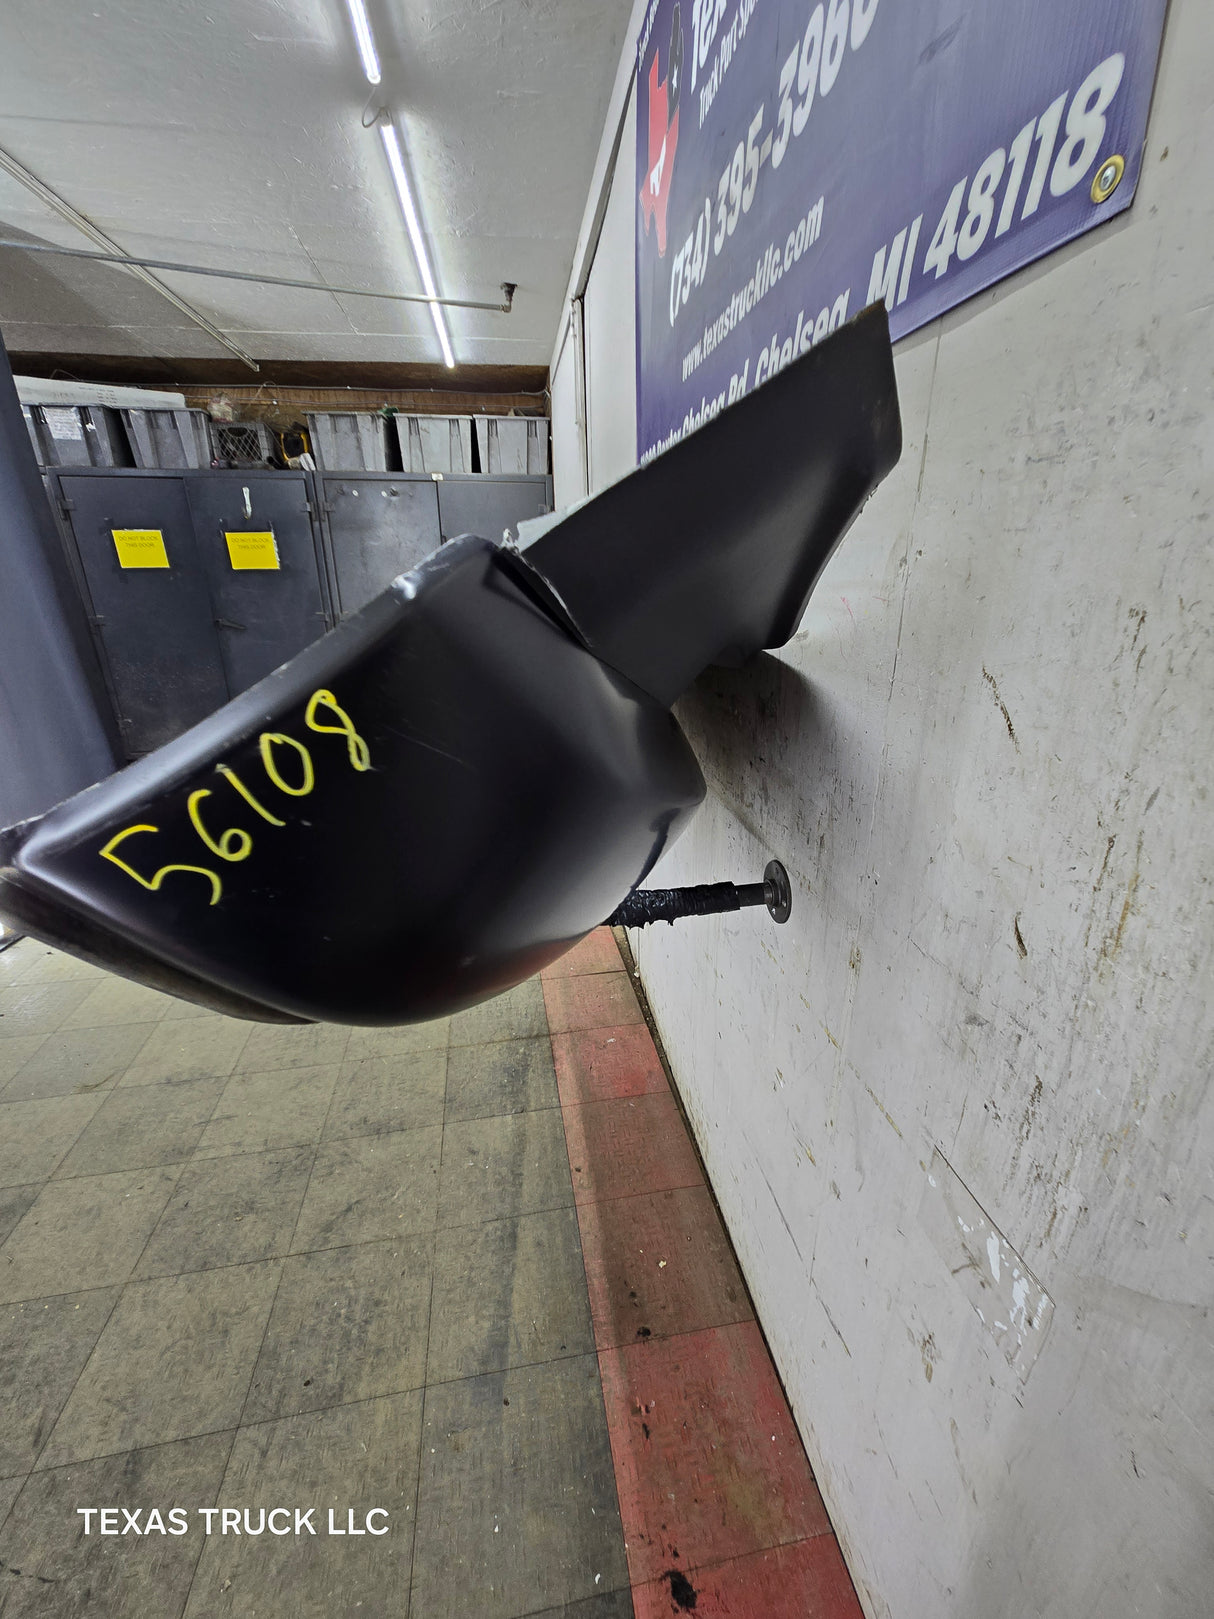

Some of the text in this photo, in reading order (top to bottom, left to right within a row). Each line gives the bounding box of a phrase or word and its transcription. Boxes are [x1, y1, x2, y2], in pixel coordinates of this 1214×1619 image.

[699, 54, 720, 130] Truck
[719, 8, 738, 86] Part
[669, 197, 712, 327] (734)
[864, 214, 923, 312] MI
[922, 52, 1126, 279] 48118
[682, 195, 825, 382] www.texastruckllc.com
[99, 689, 371, 906] 56108
